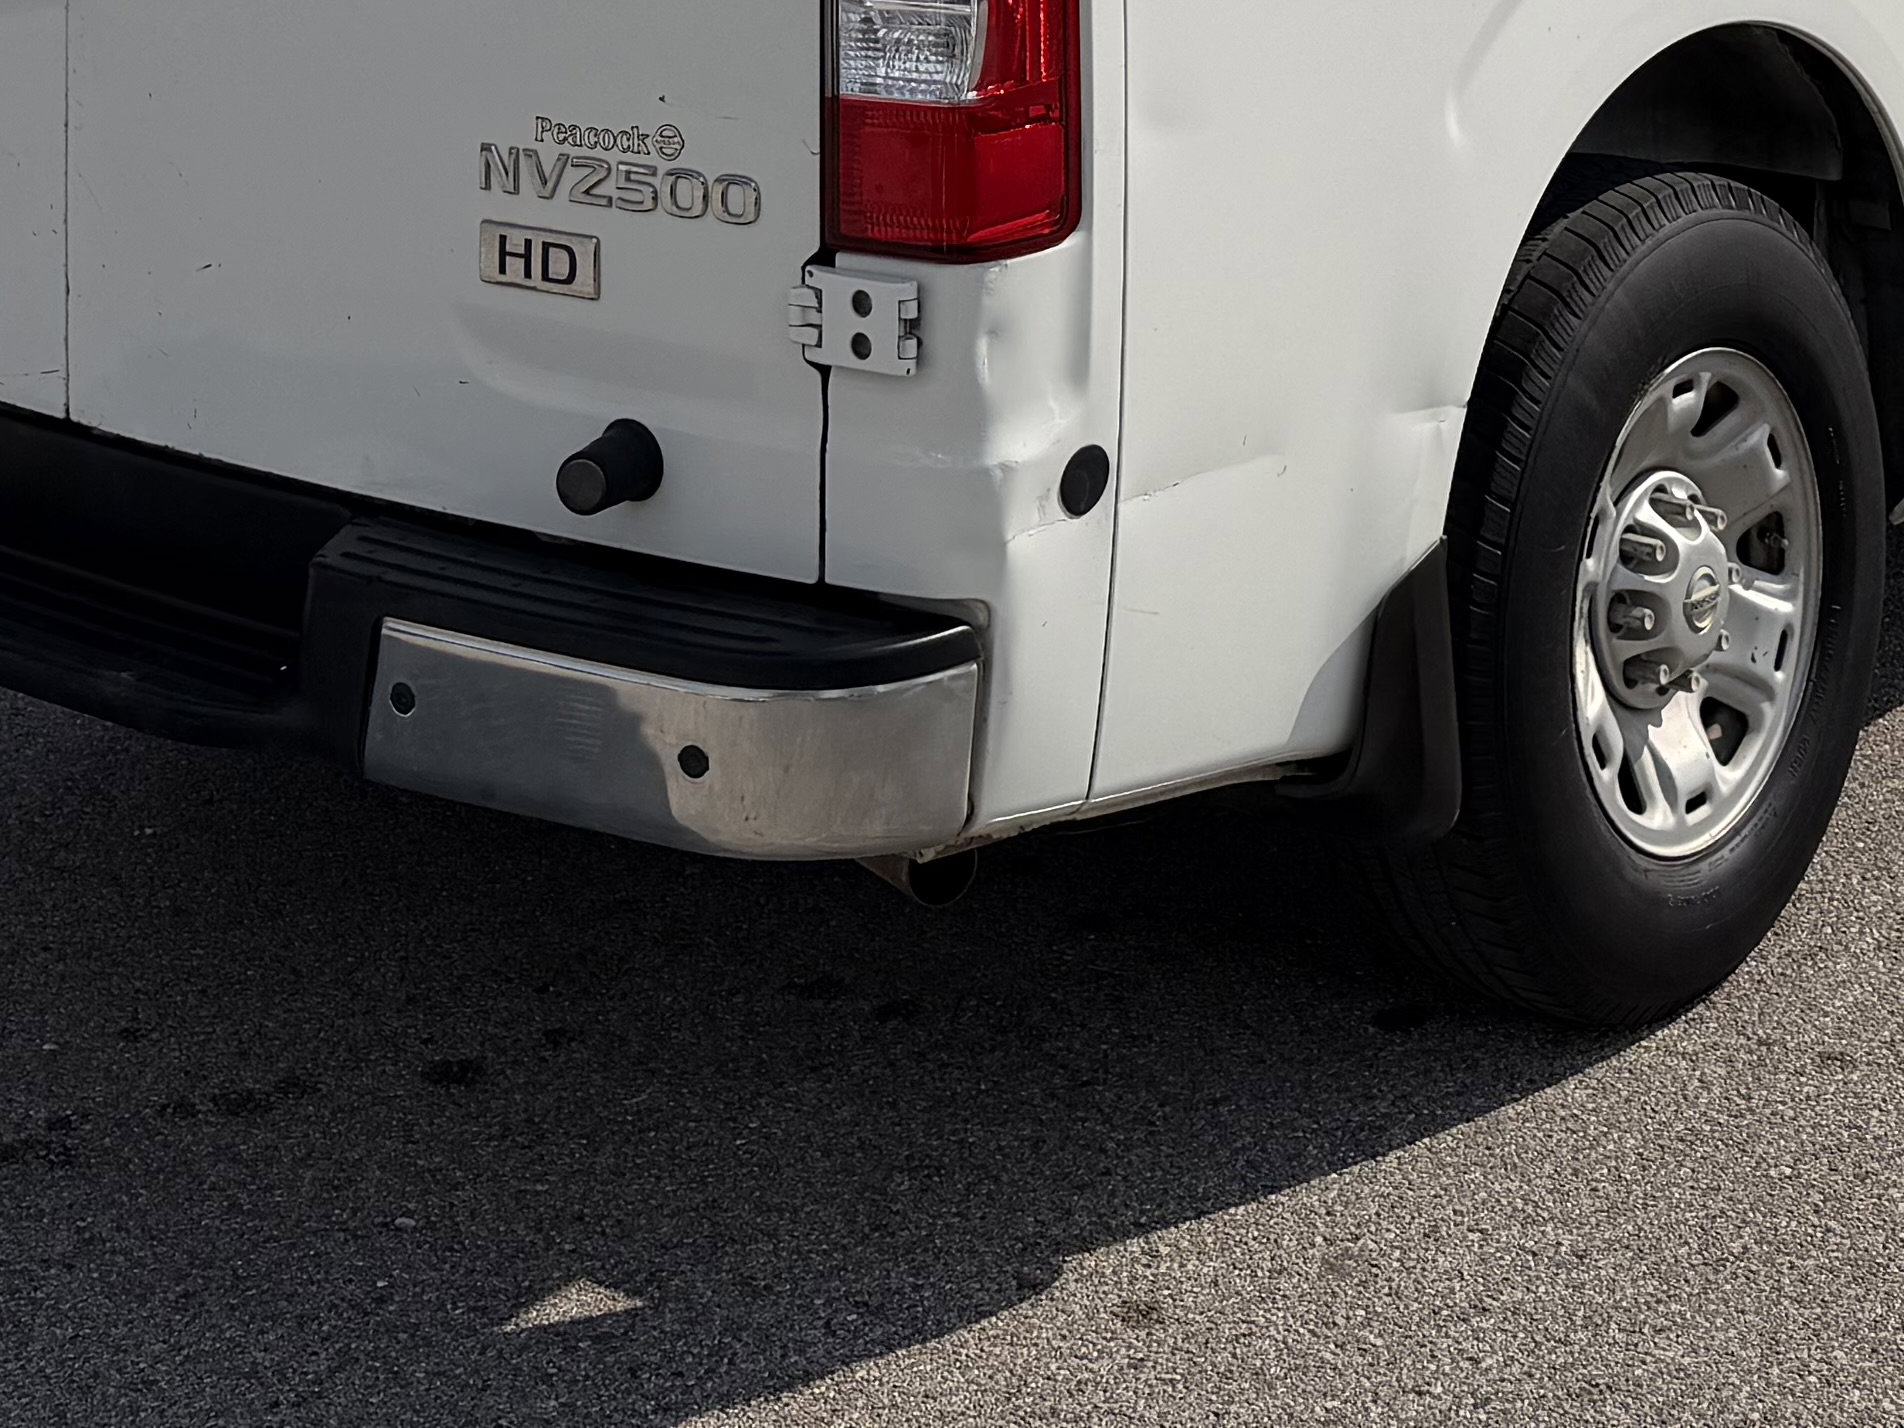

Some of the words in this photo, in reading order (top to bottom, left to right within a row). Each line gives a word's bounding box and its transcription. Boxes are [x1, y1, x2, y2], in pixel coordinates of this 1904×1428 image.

[535, 115, 651, 156] Peacock
[479, 142, 762, 225] NV2500
[498, 234, 577, 286] HD
